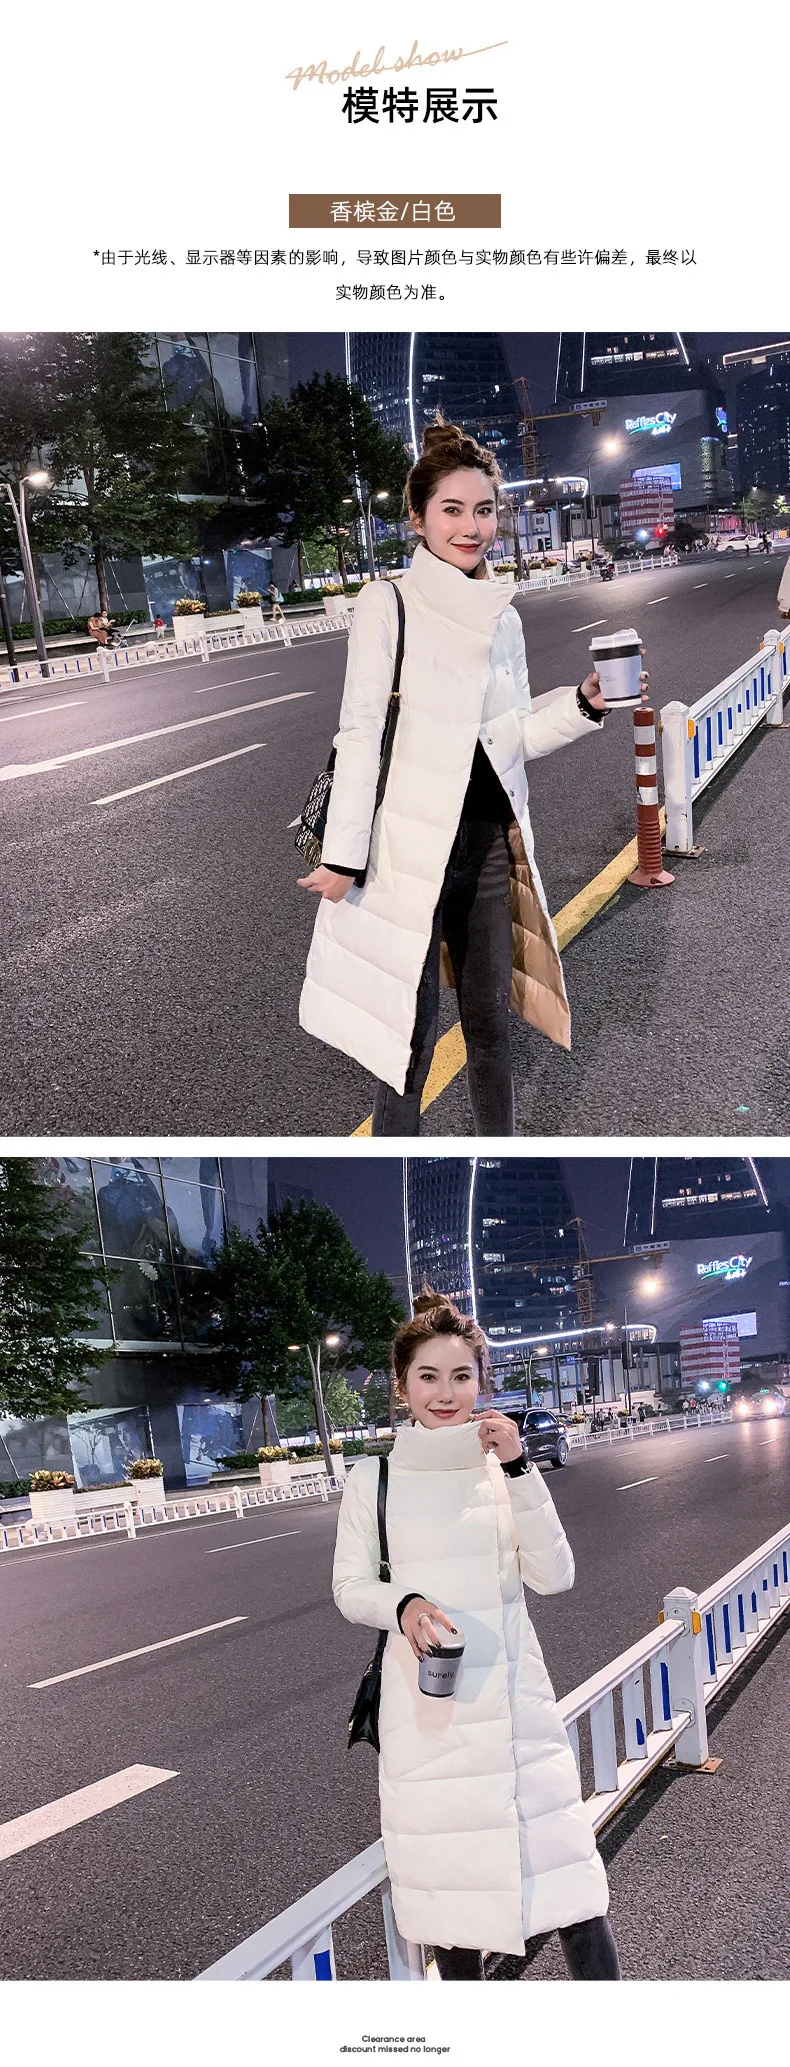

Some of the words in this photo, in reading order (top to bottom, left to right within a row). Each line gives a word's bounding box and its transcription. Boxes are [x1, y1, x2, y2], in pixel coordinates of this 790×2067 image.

[625, 416, 655, 430] Raffles
[655, 411, 677, 425] City
[697, 1260, 729, 1275] Raffles
[729, 1254, 753, 1269] City
